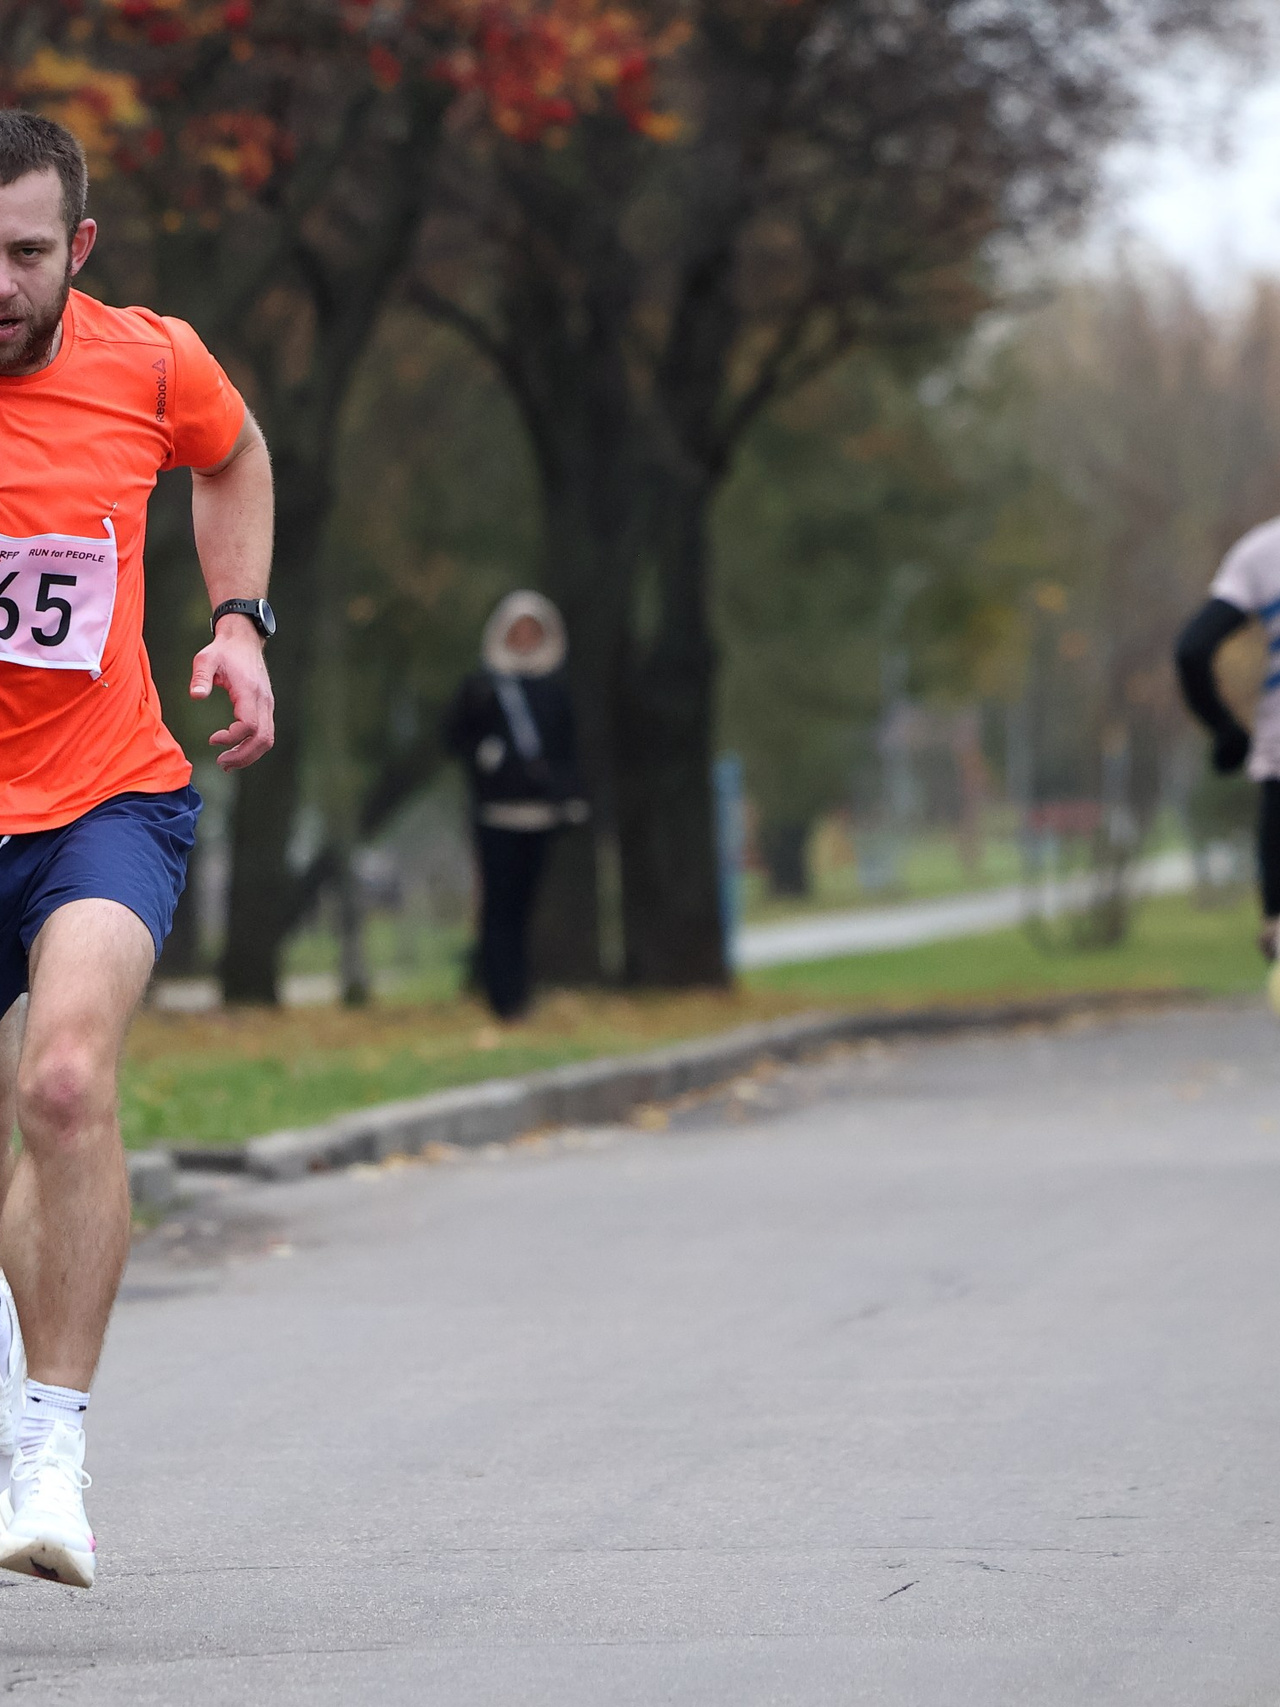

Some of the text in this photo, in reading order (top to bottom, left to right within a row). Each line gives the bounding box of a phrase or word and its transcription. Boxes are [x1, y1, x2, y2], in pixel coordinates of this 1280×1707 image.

[155, 375, 167, 423] Reebok
[0, 550, 20, 560] RFP
[28, 548, 106, 563] RUN for PEOPLE
